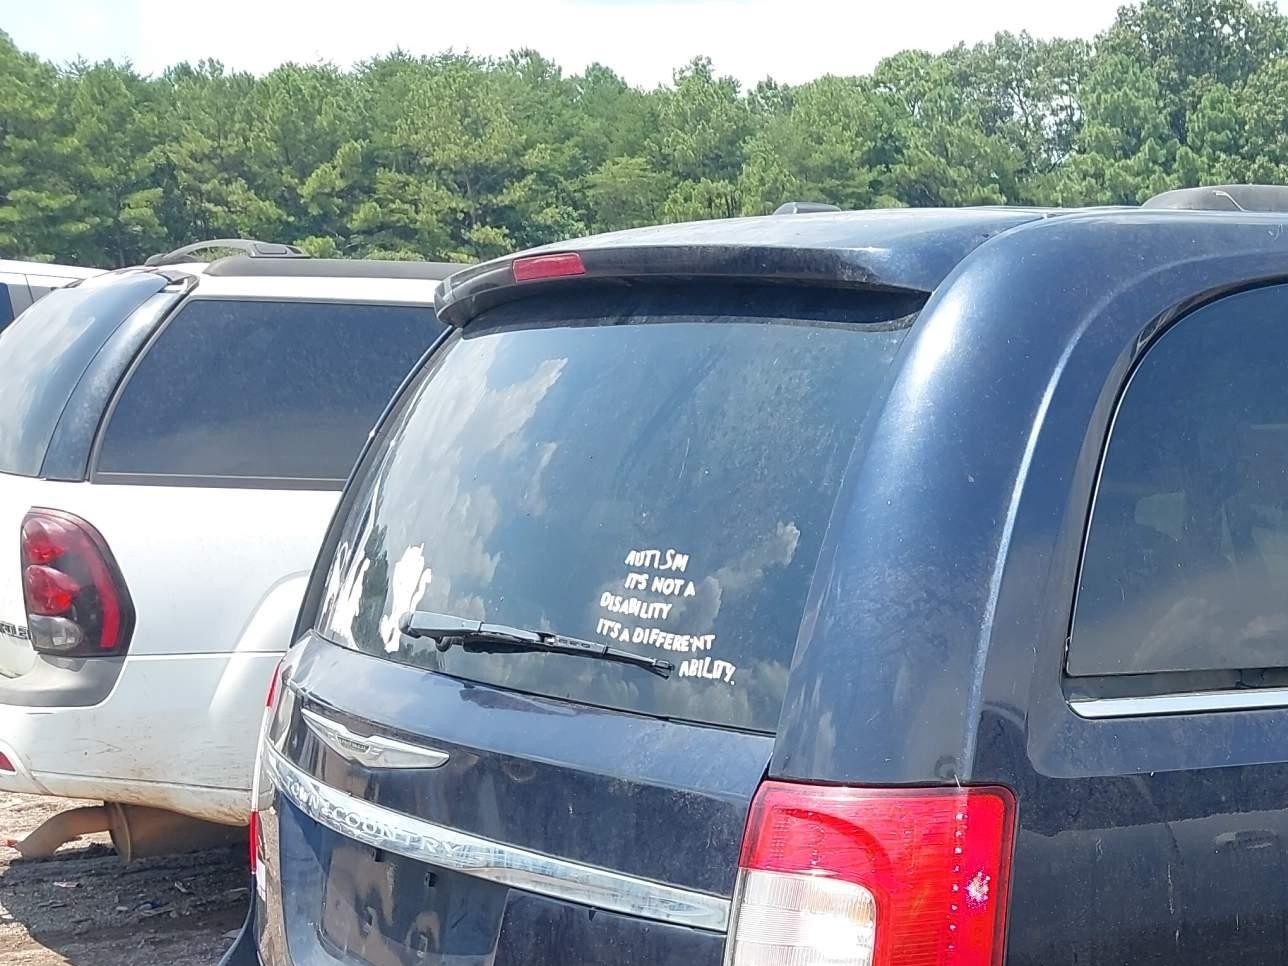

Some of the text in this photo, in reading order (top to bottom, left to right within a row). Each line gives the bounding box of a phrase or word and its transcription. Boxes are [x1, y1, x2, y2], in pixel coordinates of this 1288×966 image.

[625, 549, 689, 572] AUTISM
[652, 576, 684, 595] NOT
[684, 581, 696, 597] A
[600, 591, 673, 619] DISABILITY
[619, 628, 630, 642] A
[632, 627, 716, 652] DIFFERENT
[285, 775, 320, 810] TOWN
[332, 806, 460, 857] COUNTRY
